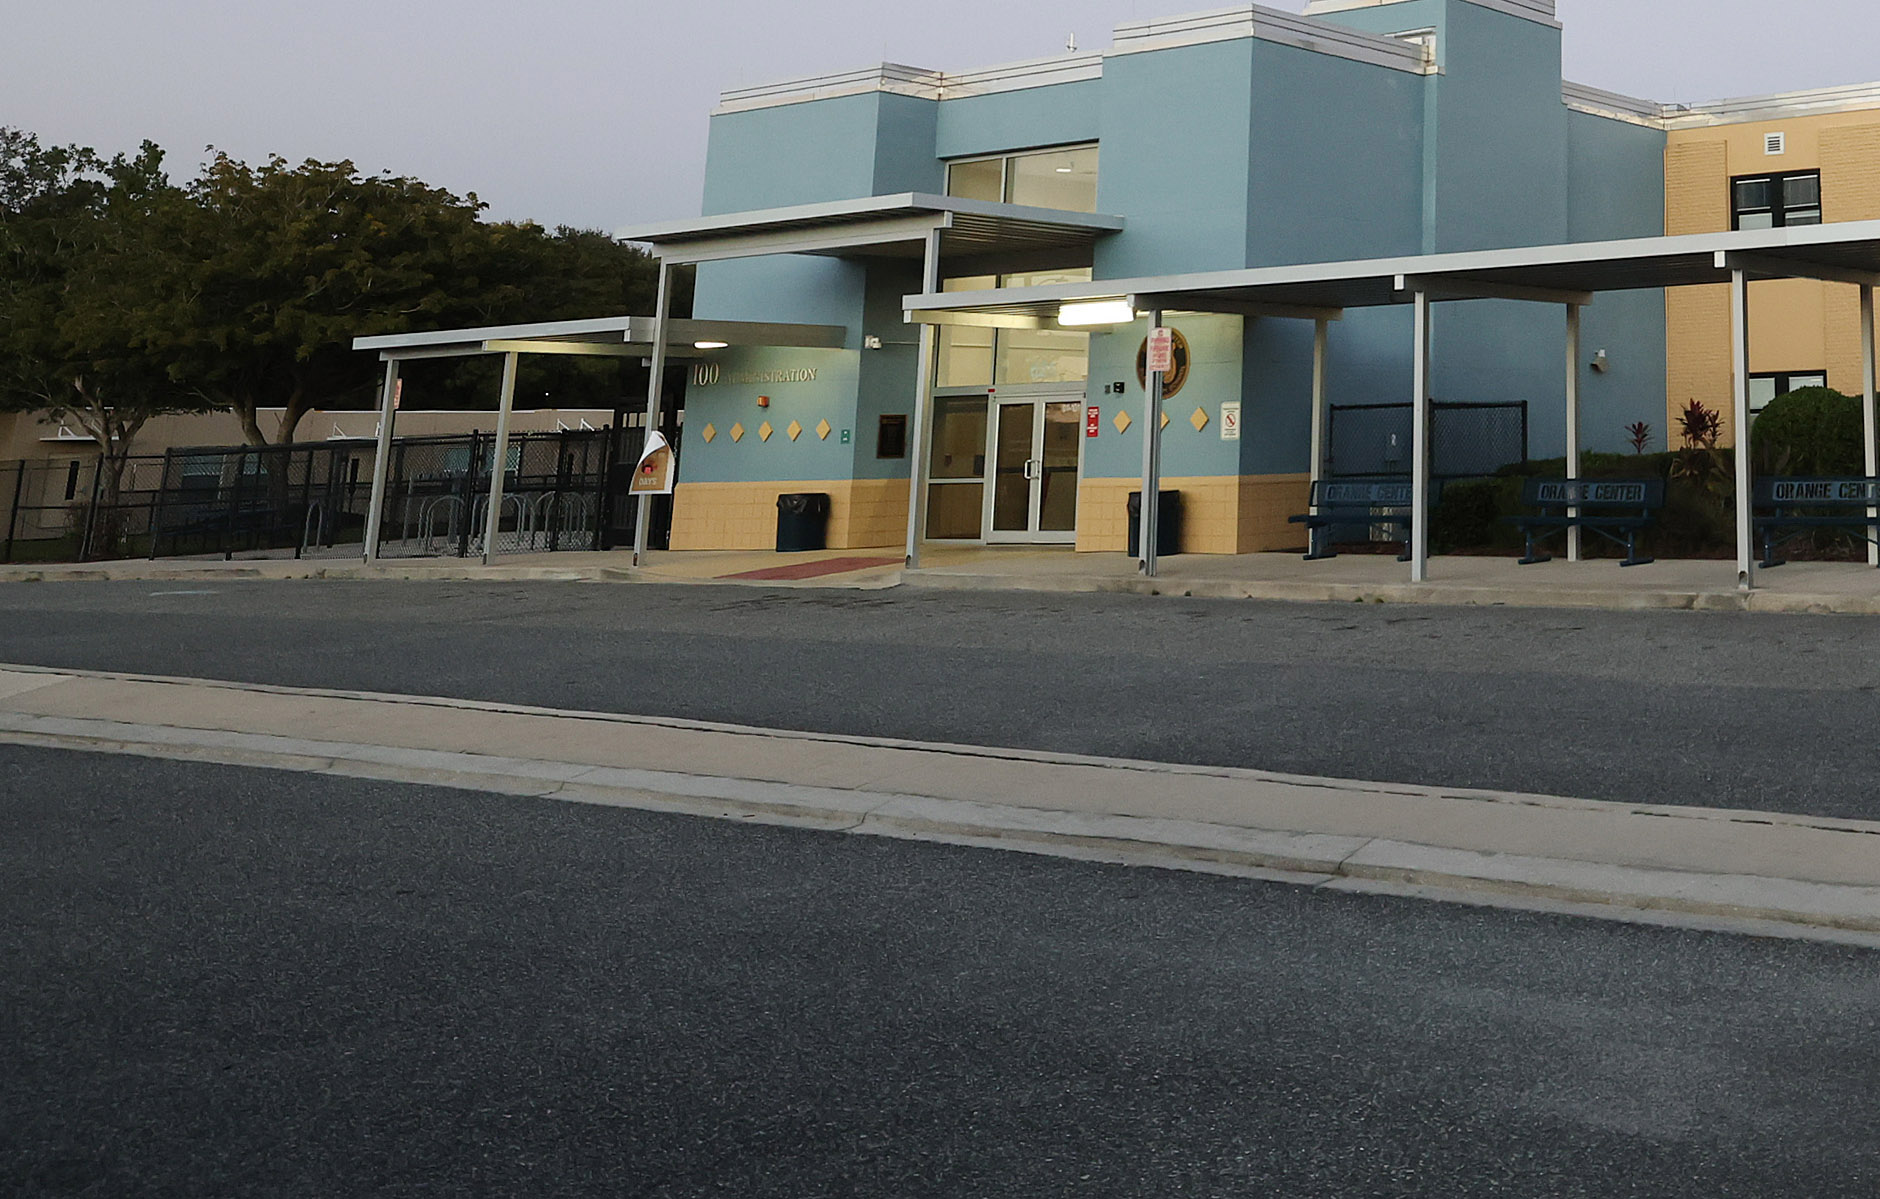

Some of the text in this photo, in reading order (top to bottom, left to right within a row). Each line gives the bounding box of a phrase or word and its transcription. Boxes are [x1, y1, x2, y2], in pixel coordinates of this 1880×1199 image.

[693, 363, 719, 386] 100
[1541, 484, 1642, 500] ORANE CENTER
[1776, 483, 1832, 499] ORANGE
